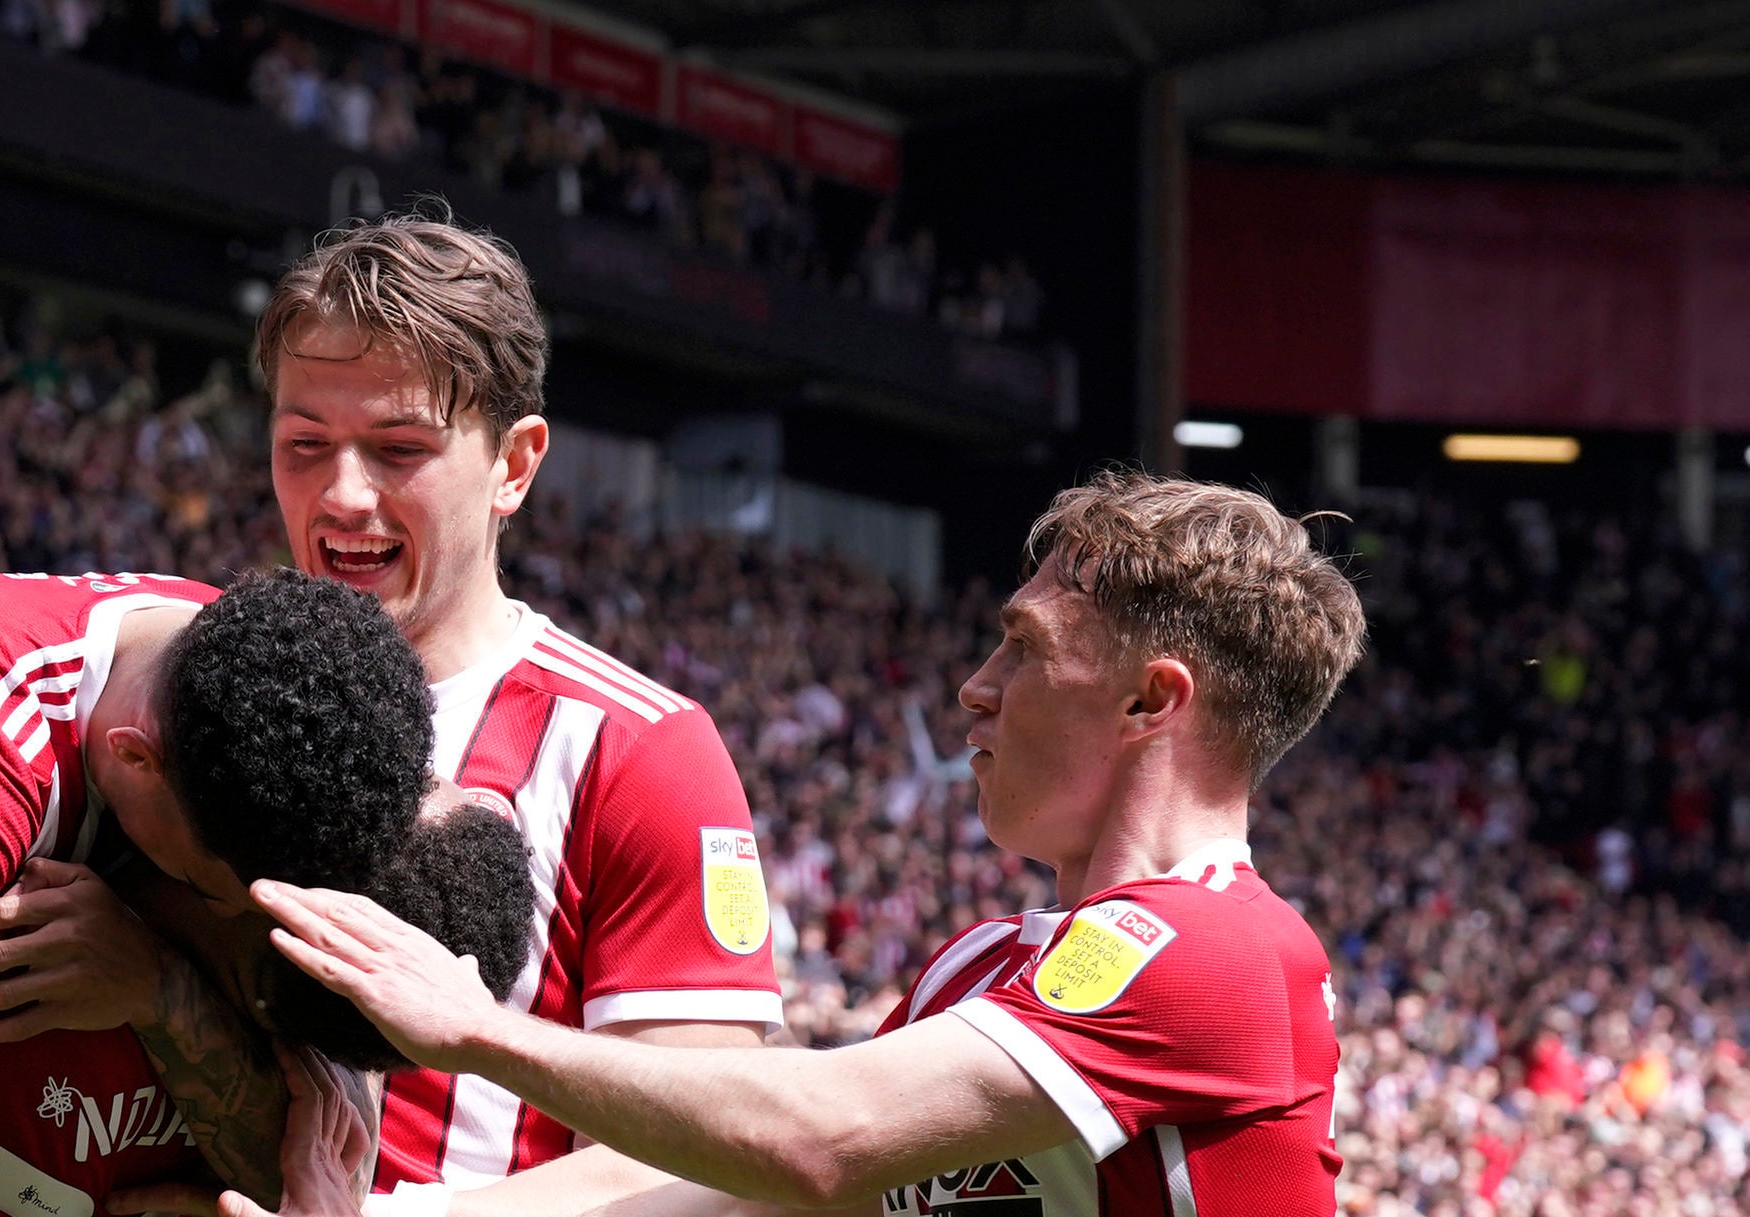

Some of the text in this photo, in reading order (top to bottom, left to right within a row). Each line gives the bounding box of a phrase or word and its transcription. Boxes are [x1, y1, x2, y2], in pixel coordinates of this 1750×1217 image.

[710, 838, 733, 856] sky
[1083, 926, 1124, 952] STAY IN
[1121, 912, 1157, 942] bet
[1069, 935, 1120, 969] CONTROL.
[1072, 948, 1100, 969] SET A
[1054, 967, 1086, 988] LIMIT
[1056, 955, 1103, 984] DEPOSIT
